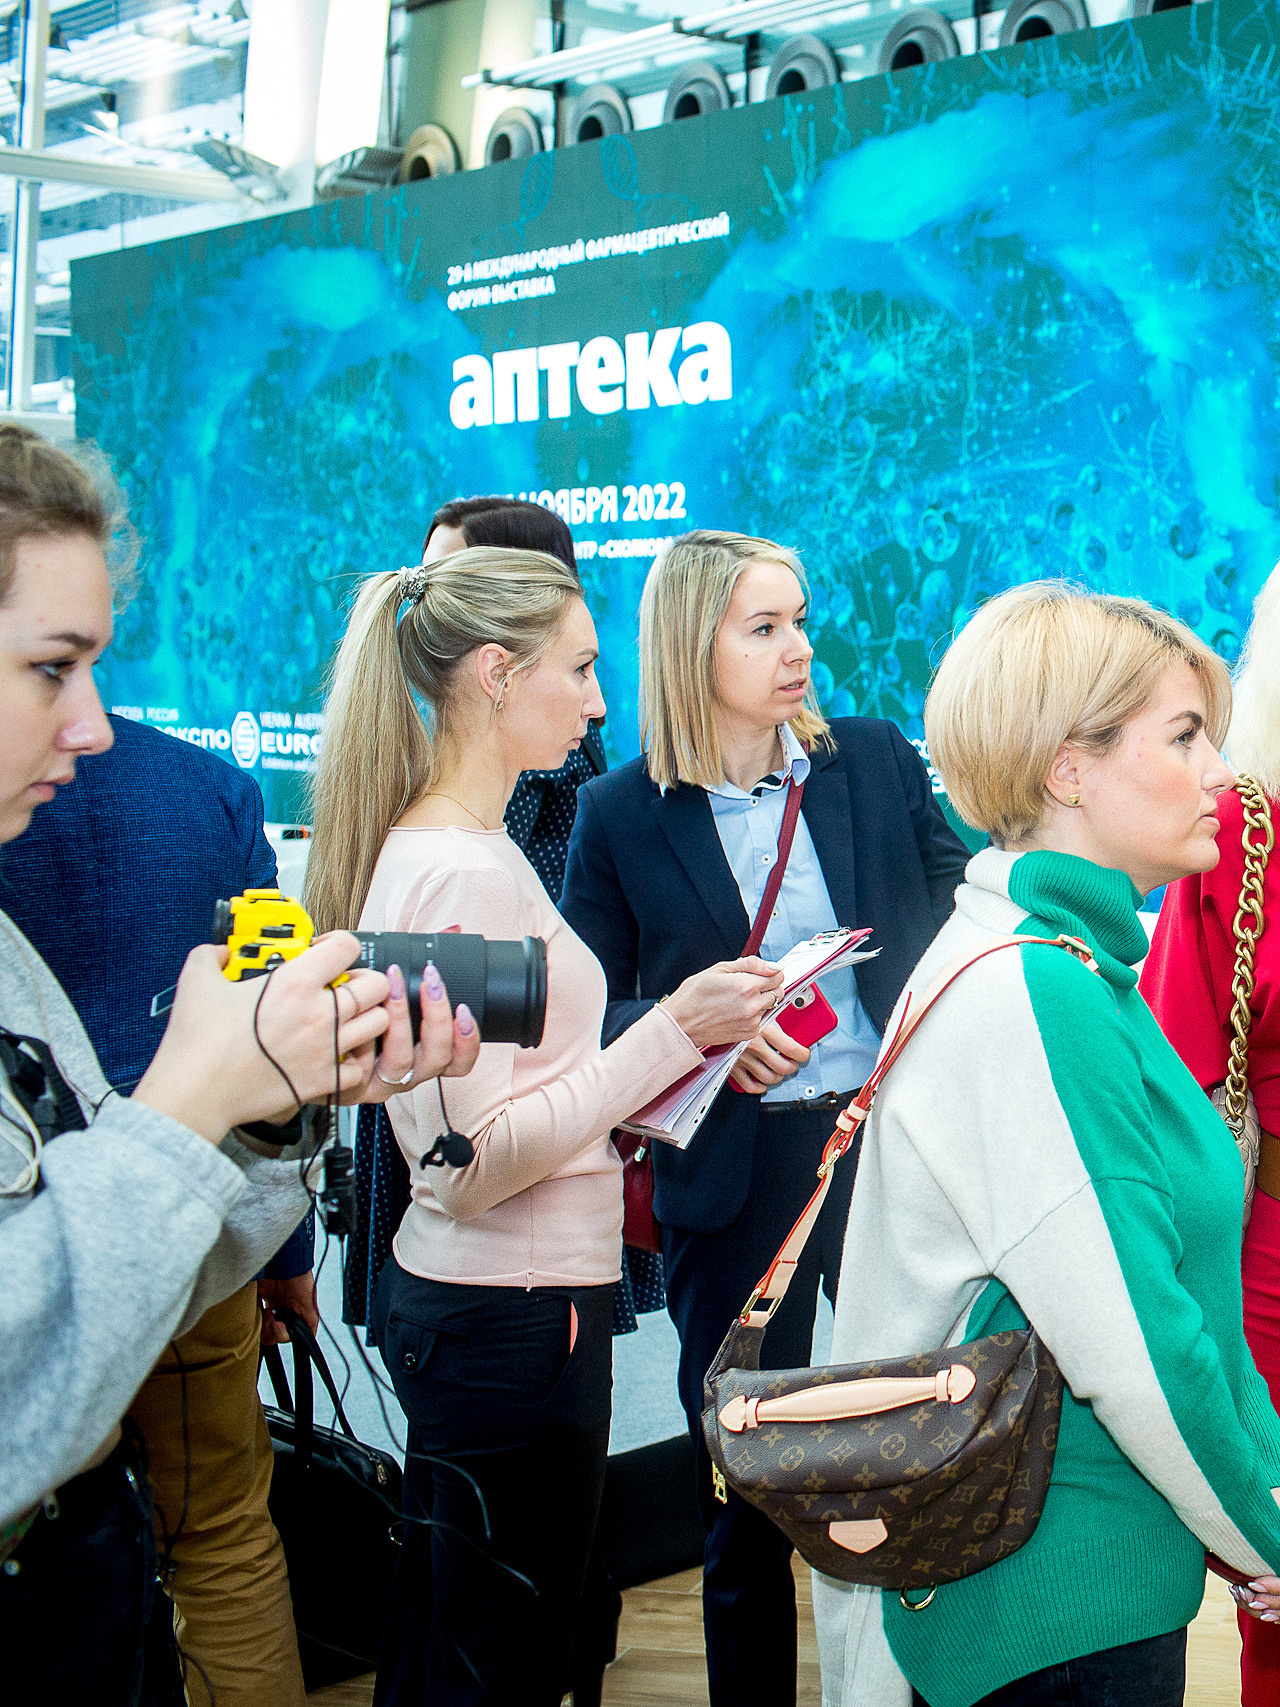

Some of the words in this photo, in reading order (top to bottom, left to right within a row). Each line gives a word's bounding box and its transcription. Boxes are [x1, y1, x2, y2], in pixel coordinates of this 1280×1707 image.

[473, 239, 585, 280] МЕЖДУНАРОДНЫЙ
[585, 211, 730, 260] ФАРМАЦЕВТИЧЕСКИЙ
[450, 321, 732, 430] аптека
[518, 485, 619, 525] ОЯБРЯ
[622, 481, 687, 522] 2022
[573, 541, 597, 560] НТР
